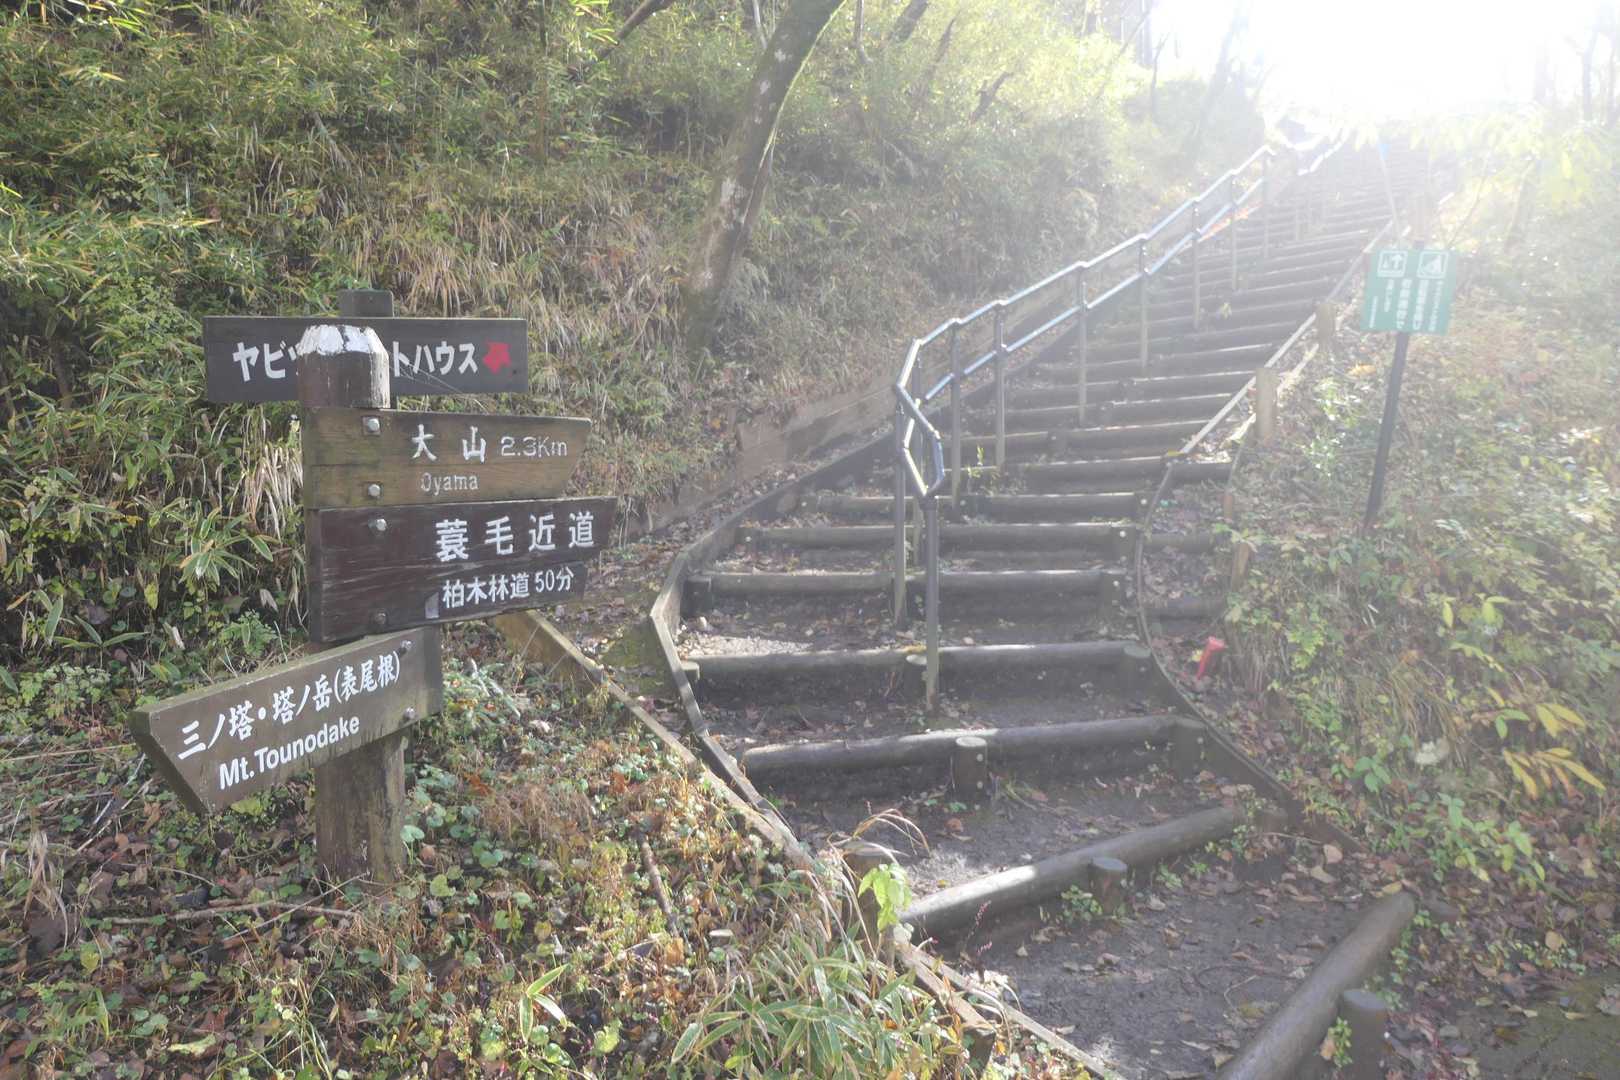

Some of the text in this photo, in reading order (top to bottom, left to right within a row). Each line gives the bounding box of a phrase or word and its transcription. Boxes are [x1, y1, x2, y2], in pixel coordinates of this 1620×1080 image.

[232, 340, 478, 382] ヤビトハウス
[421, 472, 479, 496] Oyama
[435, 510, 594, 562] 蓑毛近道
[442, 566, 574, 609] 柏木林道 50分
